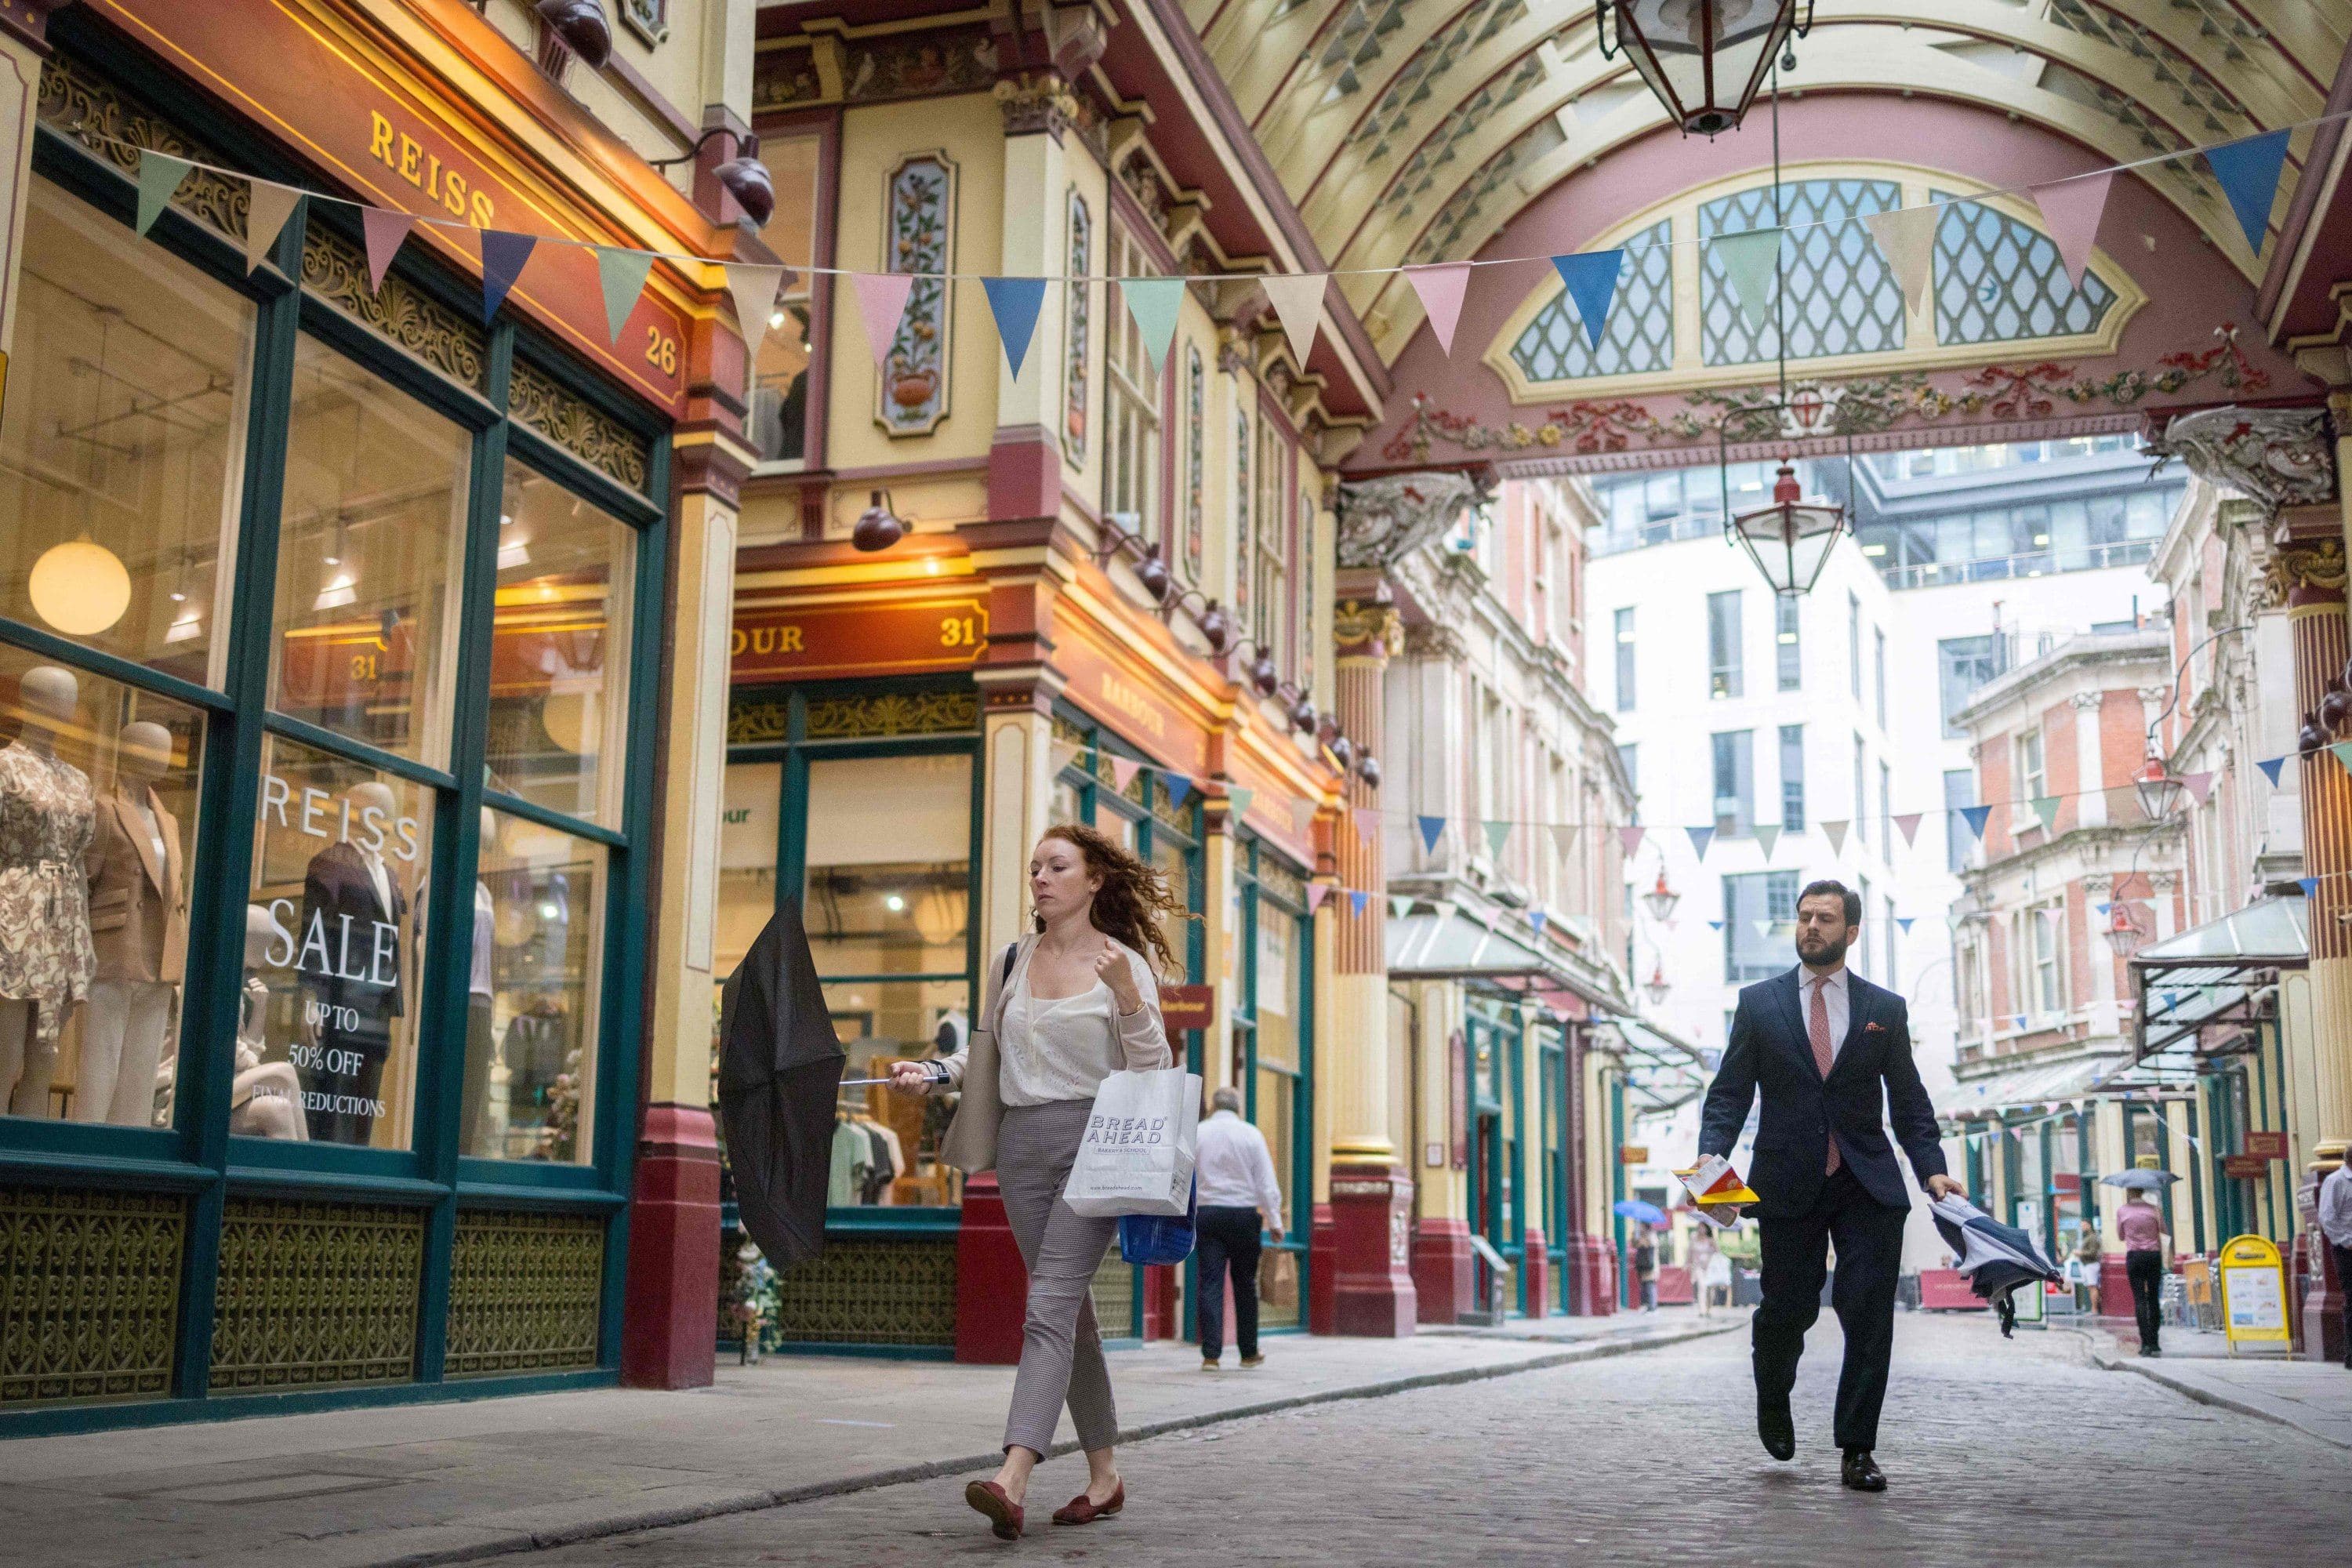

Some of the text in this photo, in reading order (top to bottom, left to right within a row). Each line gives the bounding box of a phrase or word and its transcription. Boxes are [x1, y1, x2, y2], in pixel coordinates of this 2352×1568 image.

[369, 109, 495, 230] REISS
[645, 325, 676, 376] 26
[941, 617, 975, 647] 31
[261, 775, 419, 862] REISS
[265, 898, 399, 988] SALE
[287, 1044, 364, 1076] 50% OFF
[299, 1090, 386, 1118] REDUCTIONS
[1087, 1130, 1161, 1144] AHEAD
[1091, 1115, 1164, 1131] BREAD
